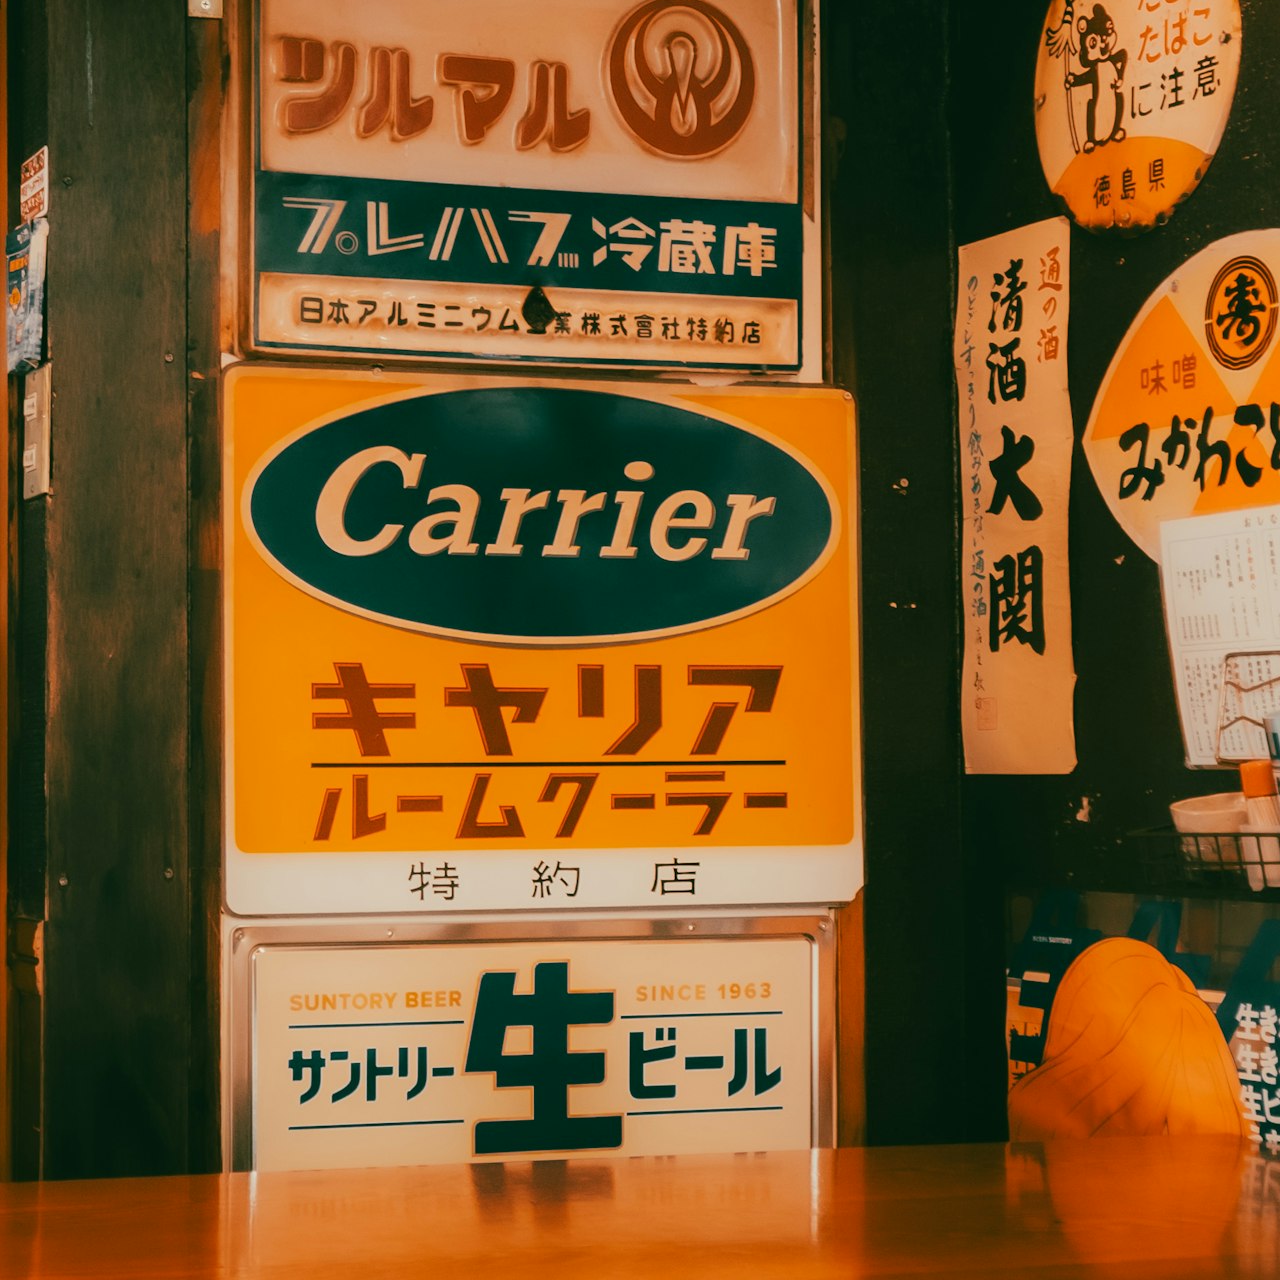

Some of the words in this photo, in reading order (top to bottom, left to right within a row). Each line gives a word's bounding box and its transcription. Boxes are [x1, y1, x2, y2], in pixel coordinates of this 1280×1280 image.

[1137, 6, 1214, 65] たばこ
[276, 34, 592, 151] ツルマル
[1129, 54, 1222, 121] に注意
[1091, 157, 1166, 210] 徳島県
[281, 195, 780, 278] プレハブ冷蔵庫
[298, 293, 763, 347] 日本アルミニウム業株式會社特約店
[1035, 244, 1065, 365] 通の酒
[1139, 354, 1198, 396] 味噌
[314, 444, 777, 563] Carrier
[312, 770, 788, 842] ルームクーラー
[407, 856, 702, 902] 特約店
[288, 991, 398, 1013] SUNTORY
[404, 989, 463, 1010] BEER
[634, 982, 708, 1003] SINCE
[717, 981, 773, 1000] 1963
